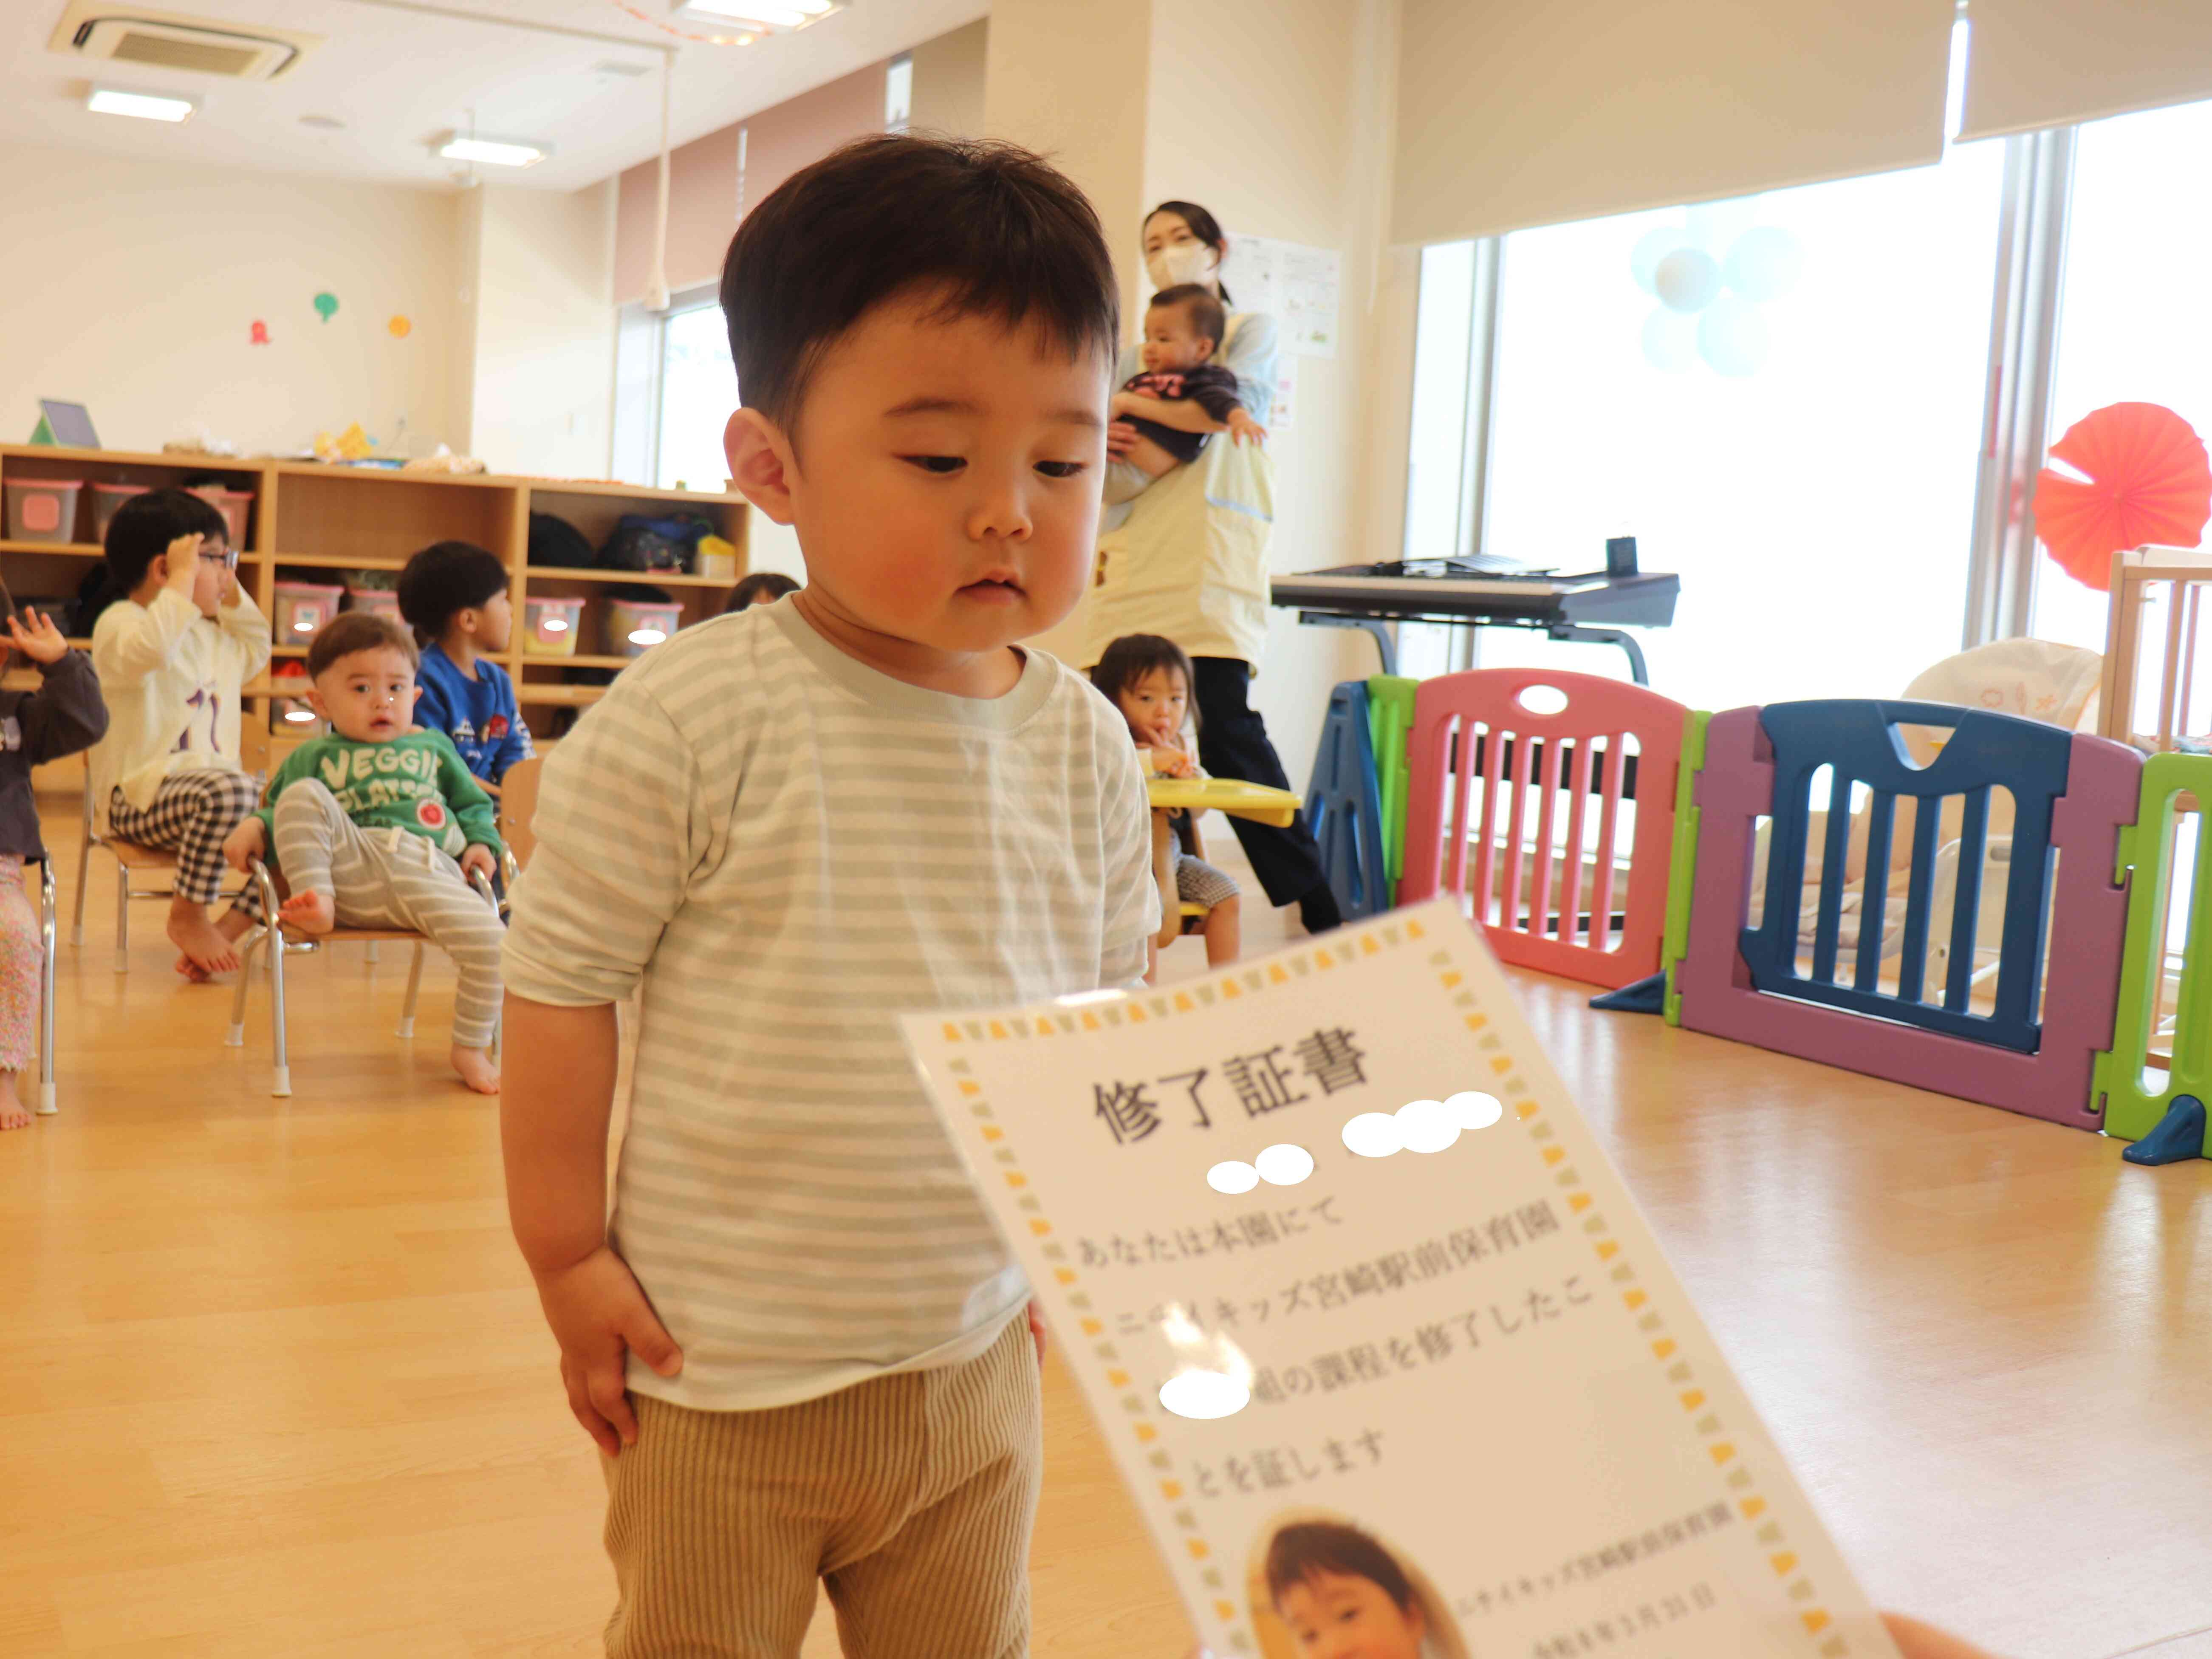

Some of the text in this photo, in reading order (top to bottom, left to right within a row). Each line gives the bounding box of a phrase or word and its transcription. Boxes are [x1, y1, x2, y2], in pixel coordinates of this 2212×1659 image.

[1092, 1026, 1370, 1147] 修了証書
[1077, 1195, 1344, 1269] あなたは本園にて
[1192, 1426, 1385, 1501] とを証します
